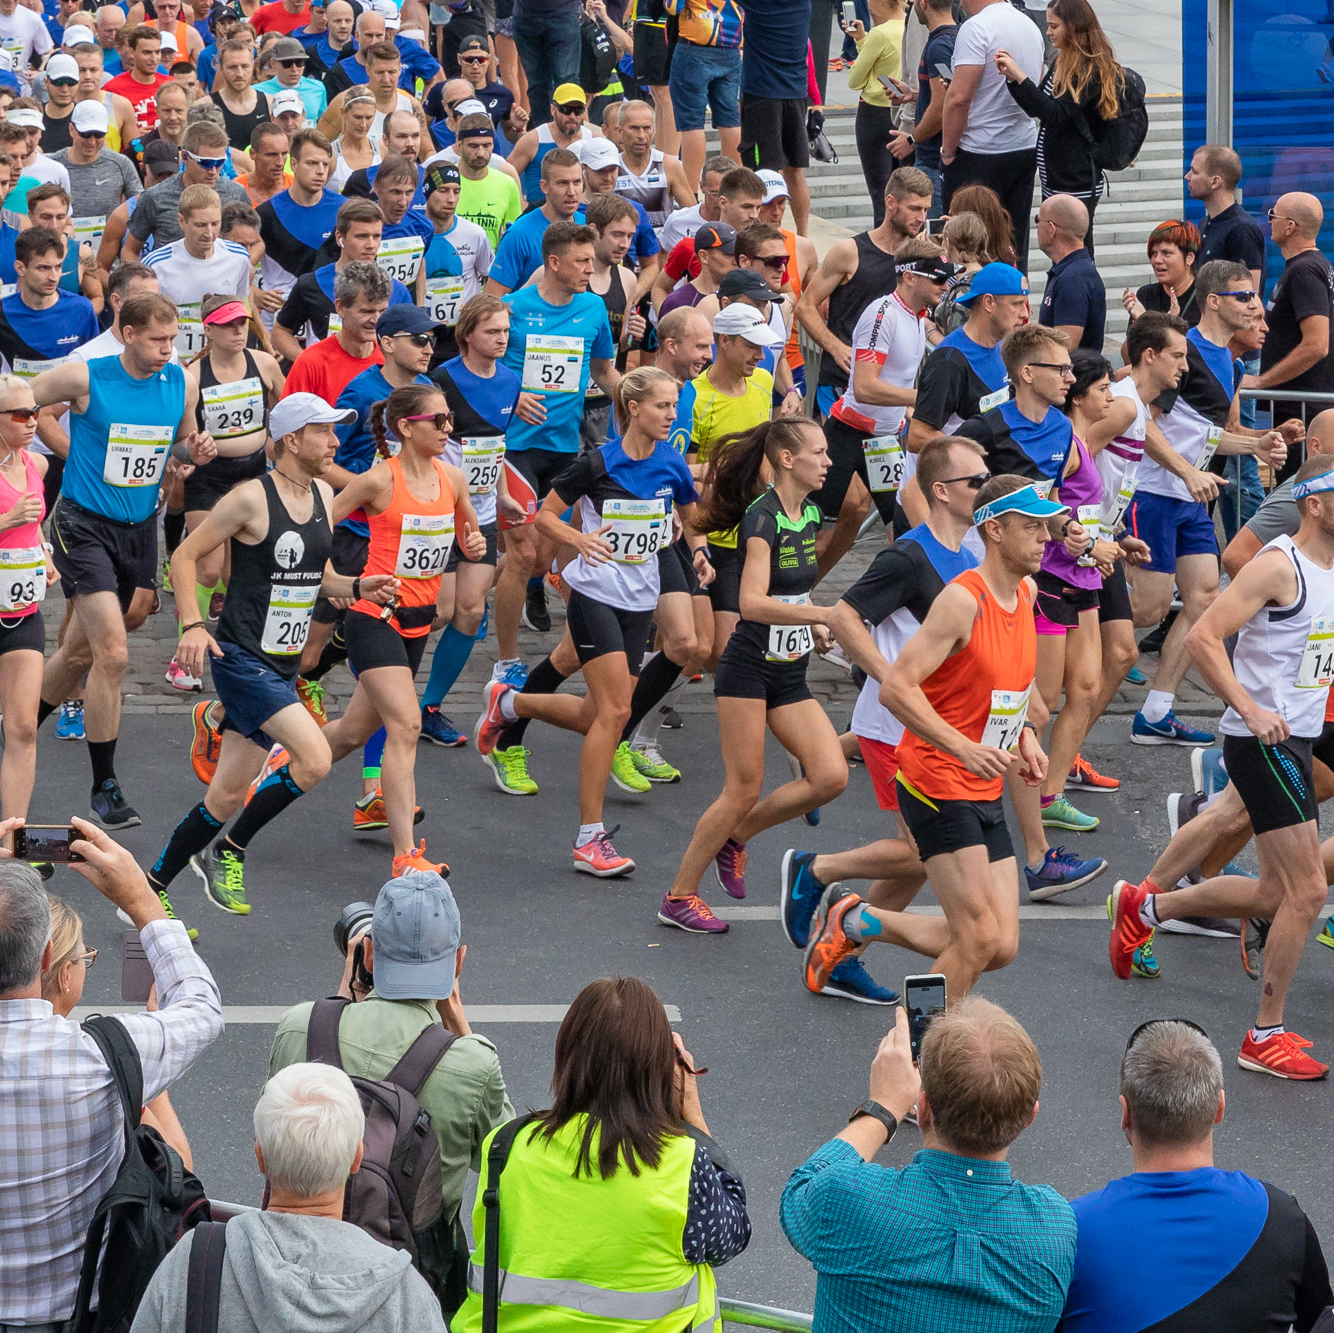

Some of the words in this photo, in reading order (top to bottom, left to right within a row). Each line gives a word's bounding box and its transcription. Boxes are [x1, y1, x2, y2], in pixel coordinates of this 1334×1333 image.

[447, 170, 458, 178] 49
[387, 262, 415, 280] 254
[435, 302, 457, 320] 67
[541, 364, 565, 384] 52
[217, 408, 254, 430] 239
[111, 446, 133, 454] URMAS
[121, 457, 157, 478] 185
[469, 465, 498, 486] 259
[605, 532, 658, 554] 3798
[403, 545, 448, 570] 3627
[283, 571, 302, 580] MUST
[10, 581, 34, 603] 93
[271, 610, 292, 618] ANTON
[276, 621, 309, 645] 205
[775, 626, 810, 652] 1679
[1307, 642, 1321, 651] JANI
[990, 717, 1008, 725] IVAR
